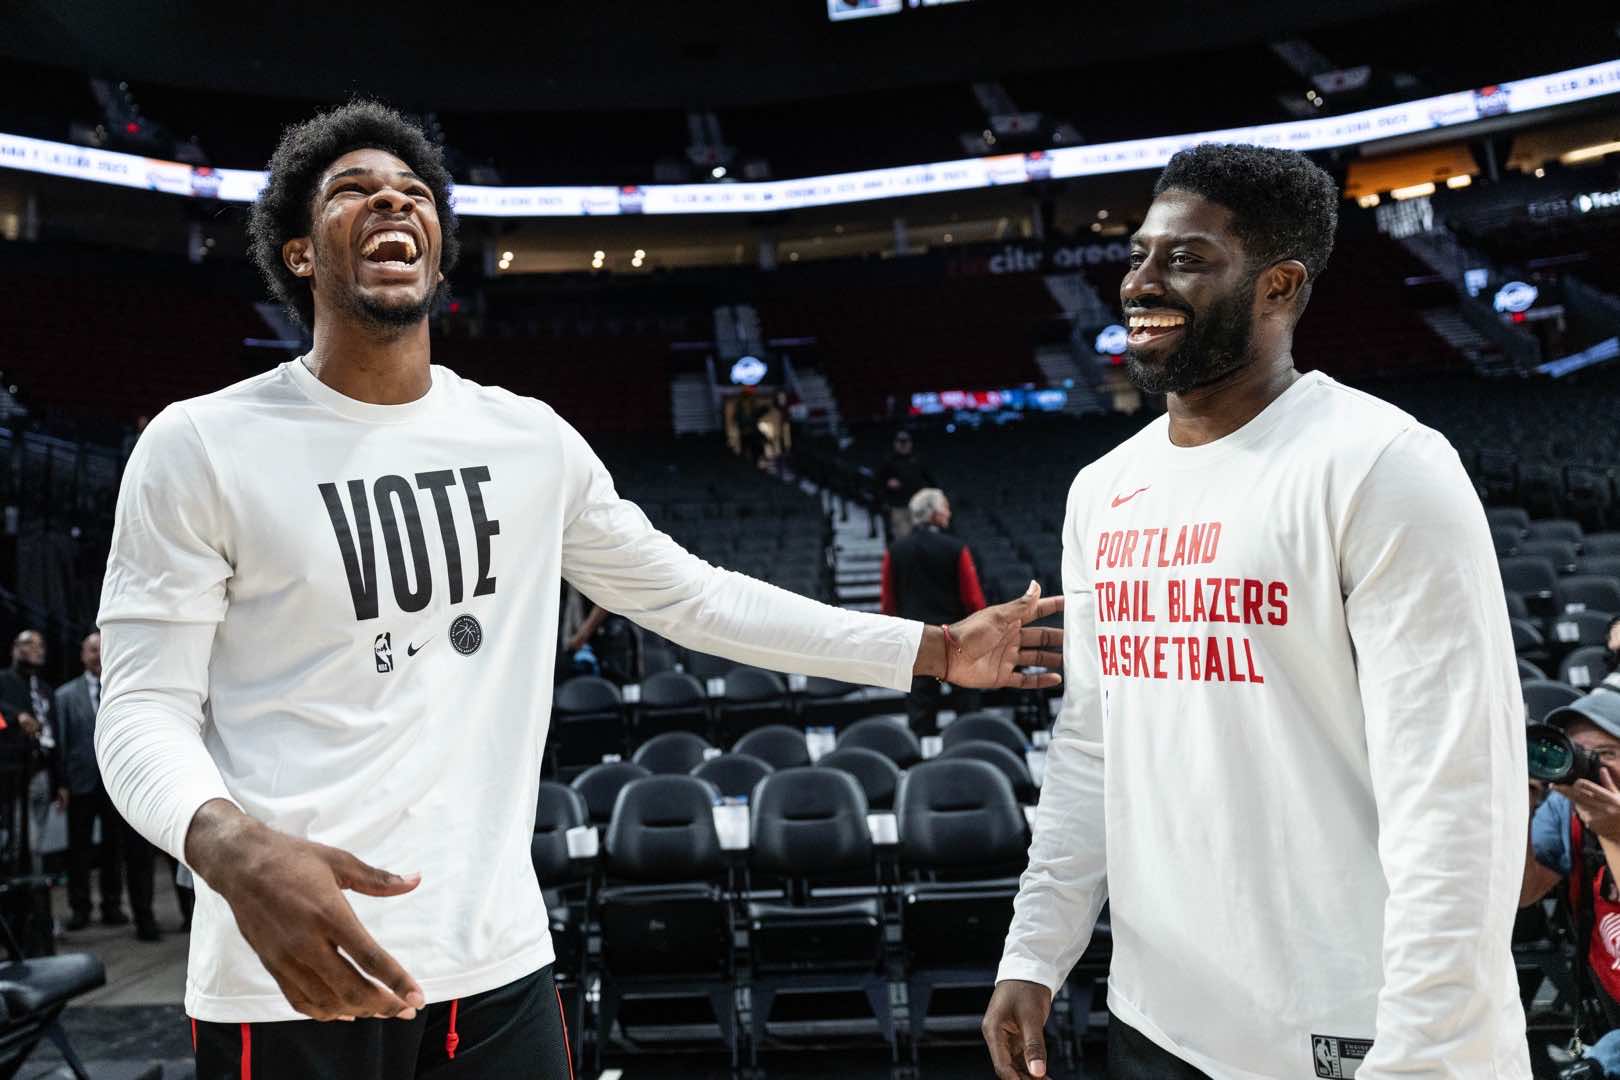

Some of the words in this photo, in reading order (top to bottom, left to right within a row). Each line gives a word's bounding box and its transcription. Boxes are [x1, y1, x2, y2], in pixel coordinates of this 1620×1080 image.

[1590, 191, 1620, 208] Tec
[317, 465, 500, 621] VOTE
[1095, 521, 1222, 570] PORTLAND
[1095, 580, 1156, 622] TRAIL
[1168, 578, 1289, 626] BLAZERS
[1098, 634, 1265, 684] BASKETBALL
